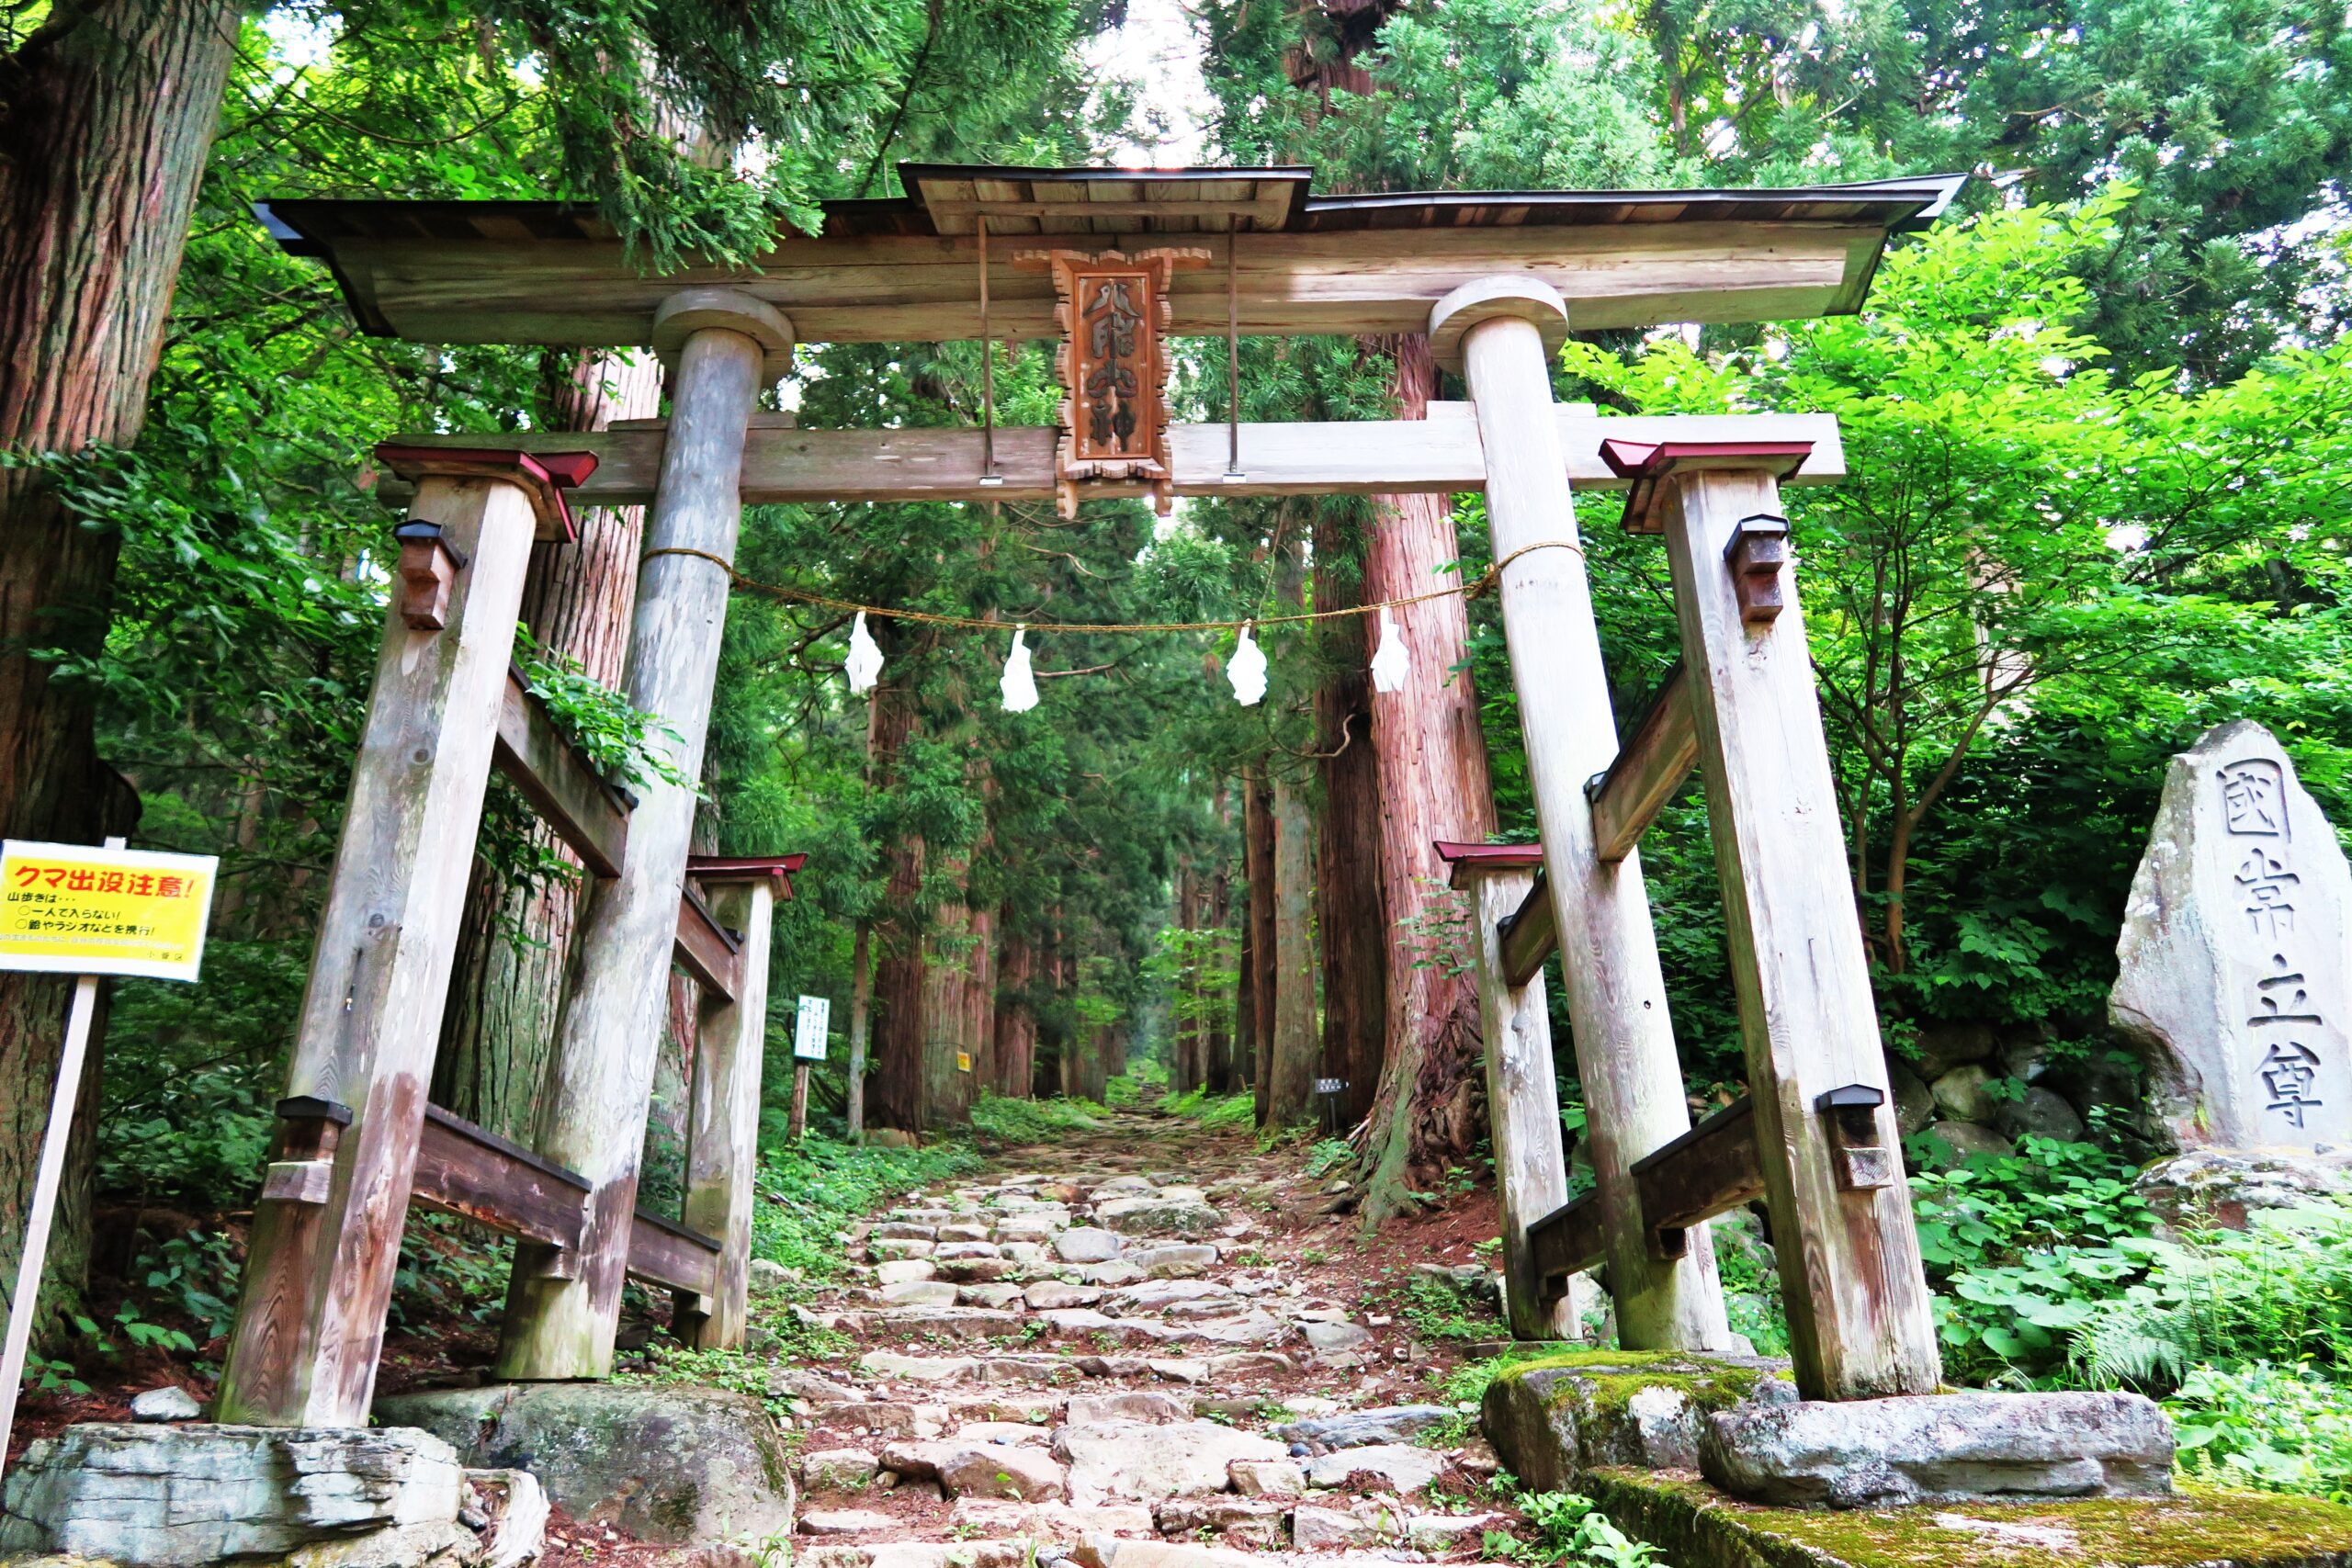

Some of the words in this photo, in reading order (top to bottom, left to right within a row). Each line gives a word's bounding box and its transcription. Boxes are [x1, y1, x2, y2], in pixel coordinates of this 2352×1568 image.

[15, 865, 194, 898] クマ出没注意!
